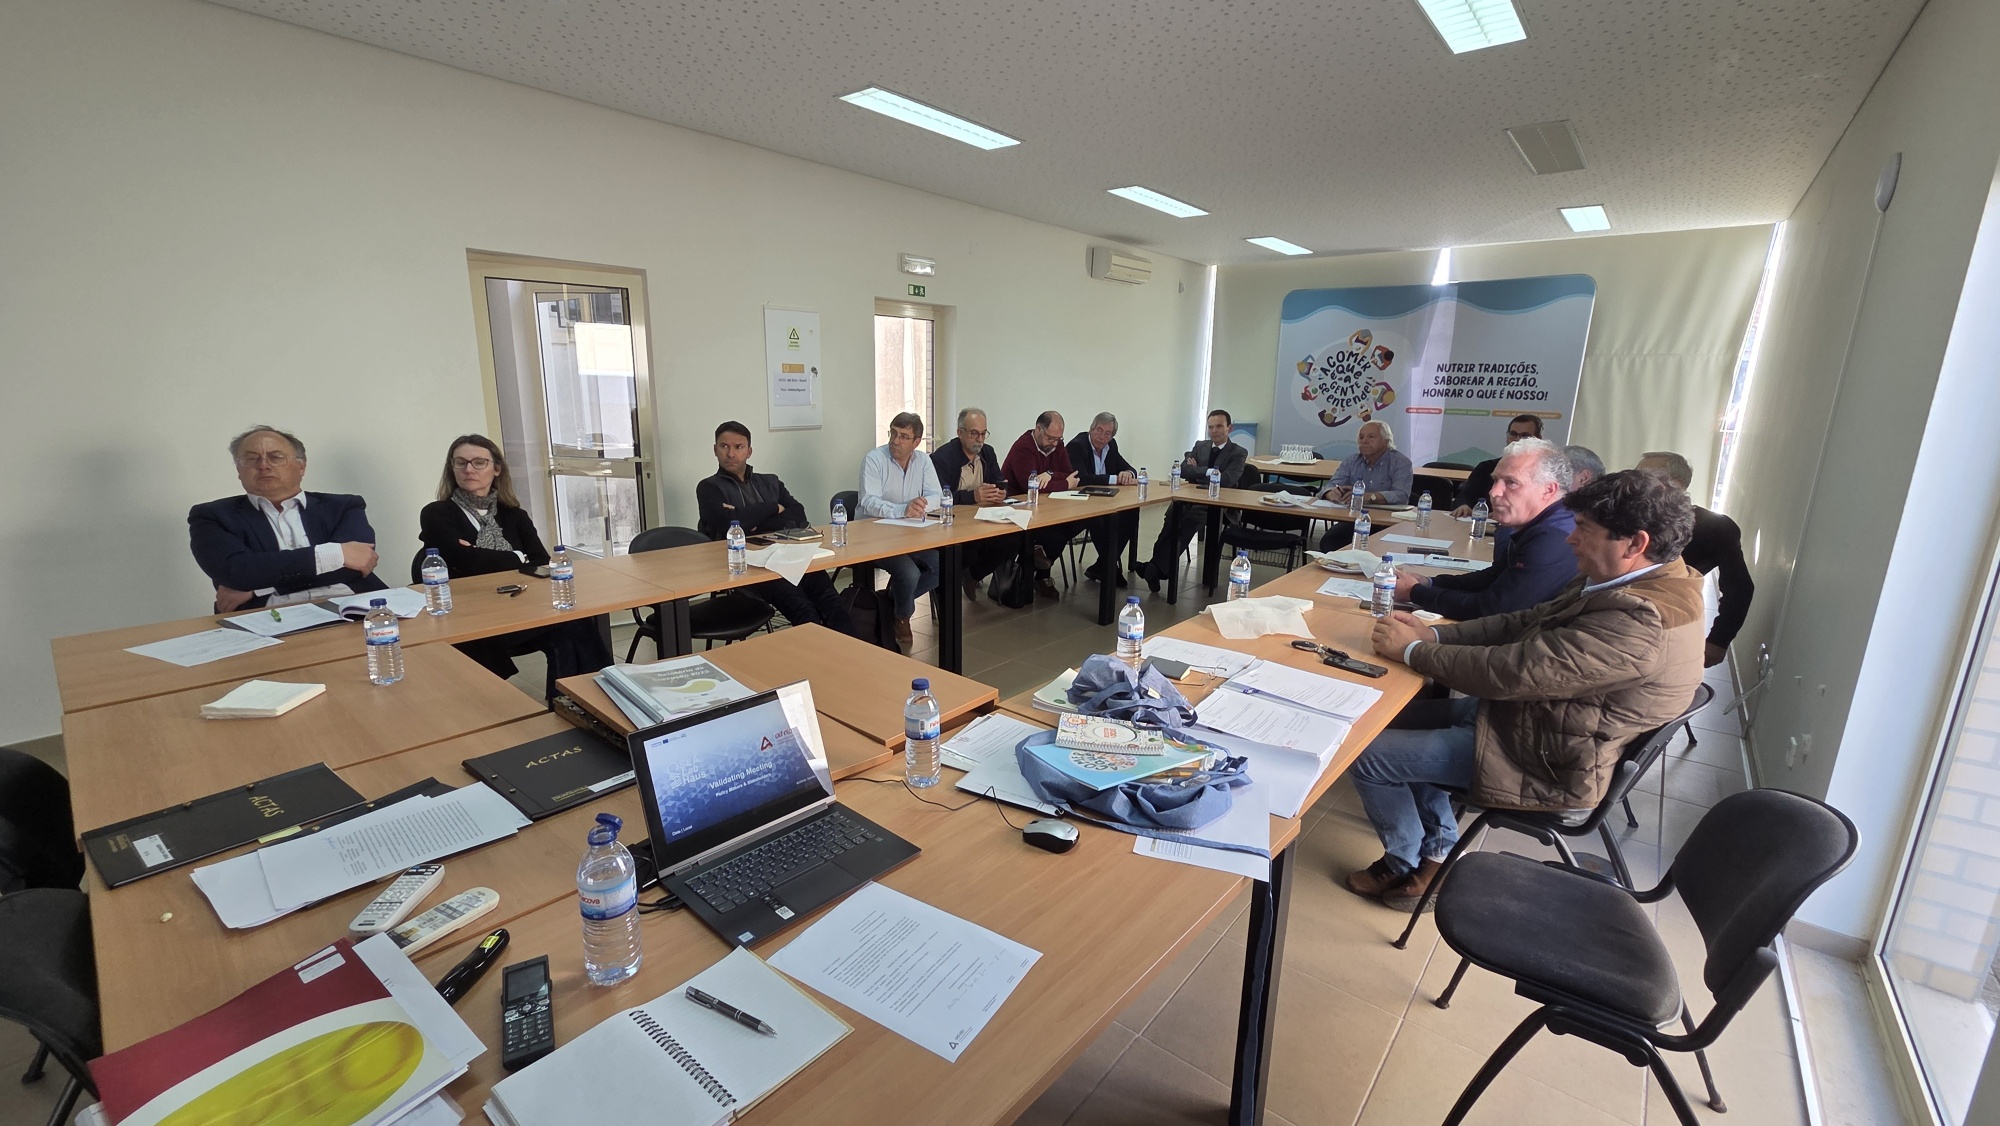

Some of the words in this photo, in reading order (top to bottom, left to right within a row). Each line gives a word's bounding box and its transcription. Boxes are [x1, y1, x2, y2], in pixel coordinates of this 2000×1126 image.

[1326, 350, 1372, 373] COMER
[1436, 363, 1475, 373] NUTRIR
[1329, 380, 1361, 397] GENTE
[1433, 375, 1486, 386] SABOREAR
[1486, 376, 1494, 386] A
[1422, 388, 1464, 398] HONRAR
[1466, 388, 1474, 398] O
[1476, 389, 1497, 399] QUE
[1499, 387, 1506, 399] É
[1506, 390, 1549, 401] NOSSO!
[524, 745, 583, 769] ACTAS
[682, 765, 699, 776] Lab
[682, 770, 707, 785] Haus
[709, 772, 745, 790] Validating
[746, 761, 773, 776] Meeting
[248, 795, 285, 818] ACTAS
